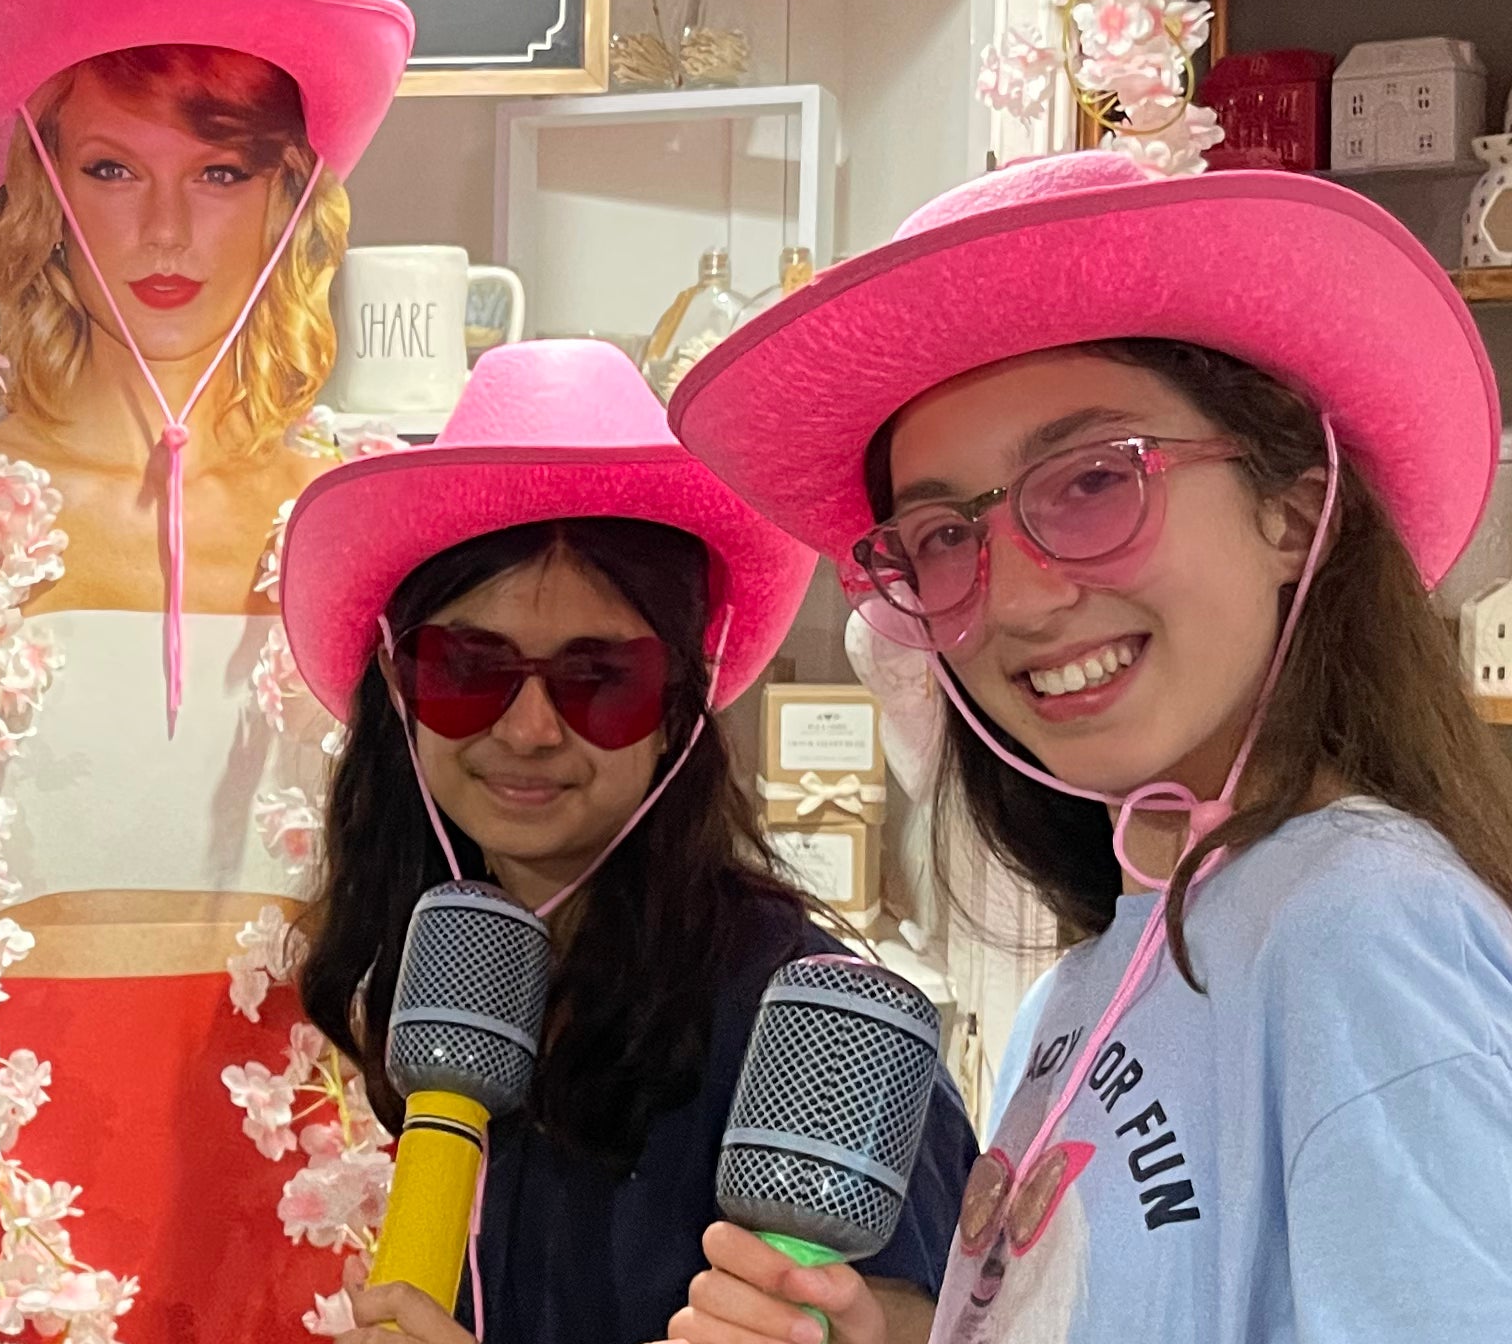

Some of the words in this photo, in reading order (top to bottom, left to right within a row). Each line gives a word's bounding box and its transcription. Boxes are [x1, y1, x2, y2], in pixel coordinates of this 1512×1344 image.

[357, 302, 438, 359] SHARE
[1089, 1041, 1144, 1114] OR
[1114, 1099, 1201, 1231] FUN
